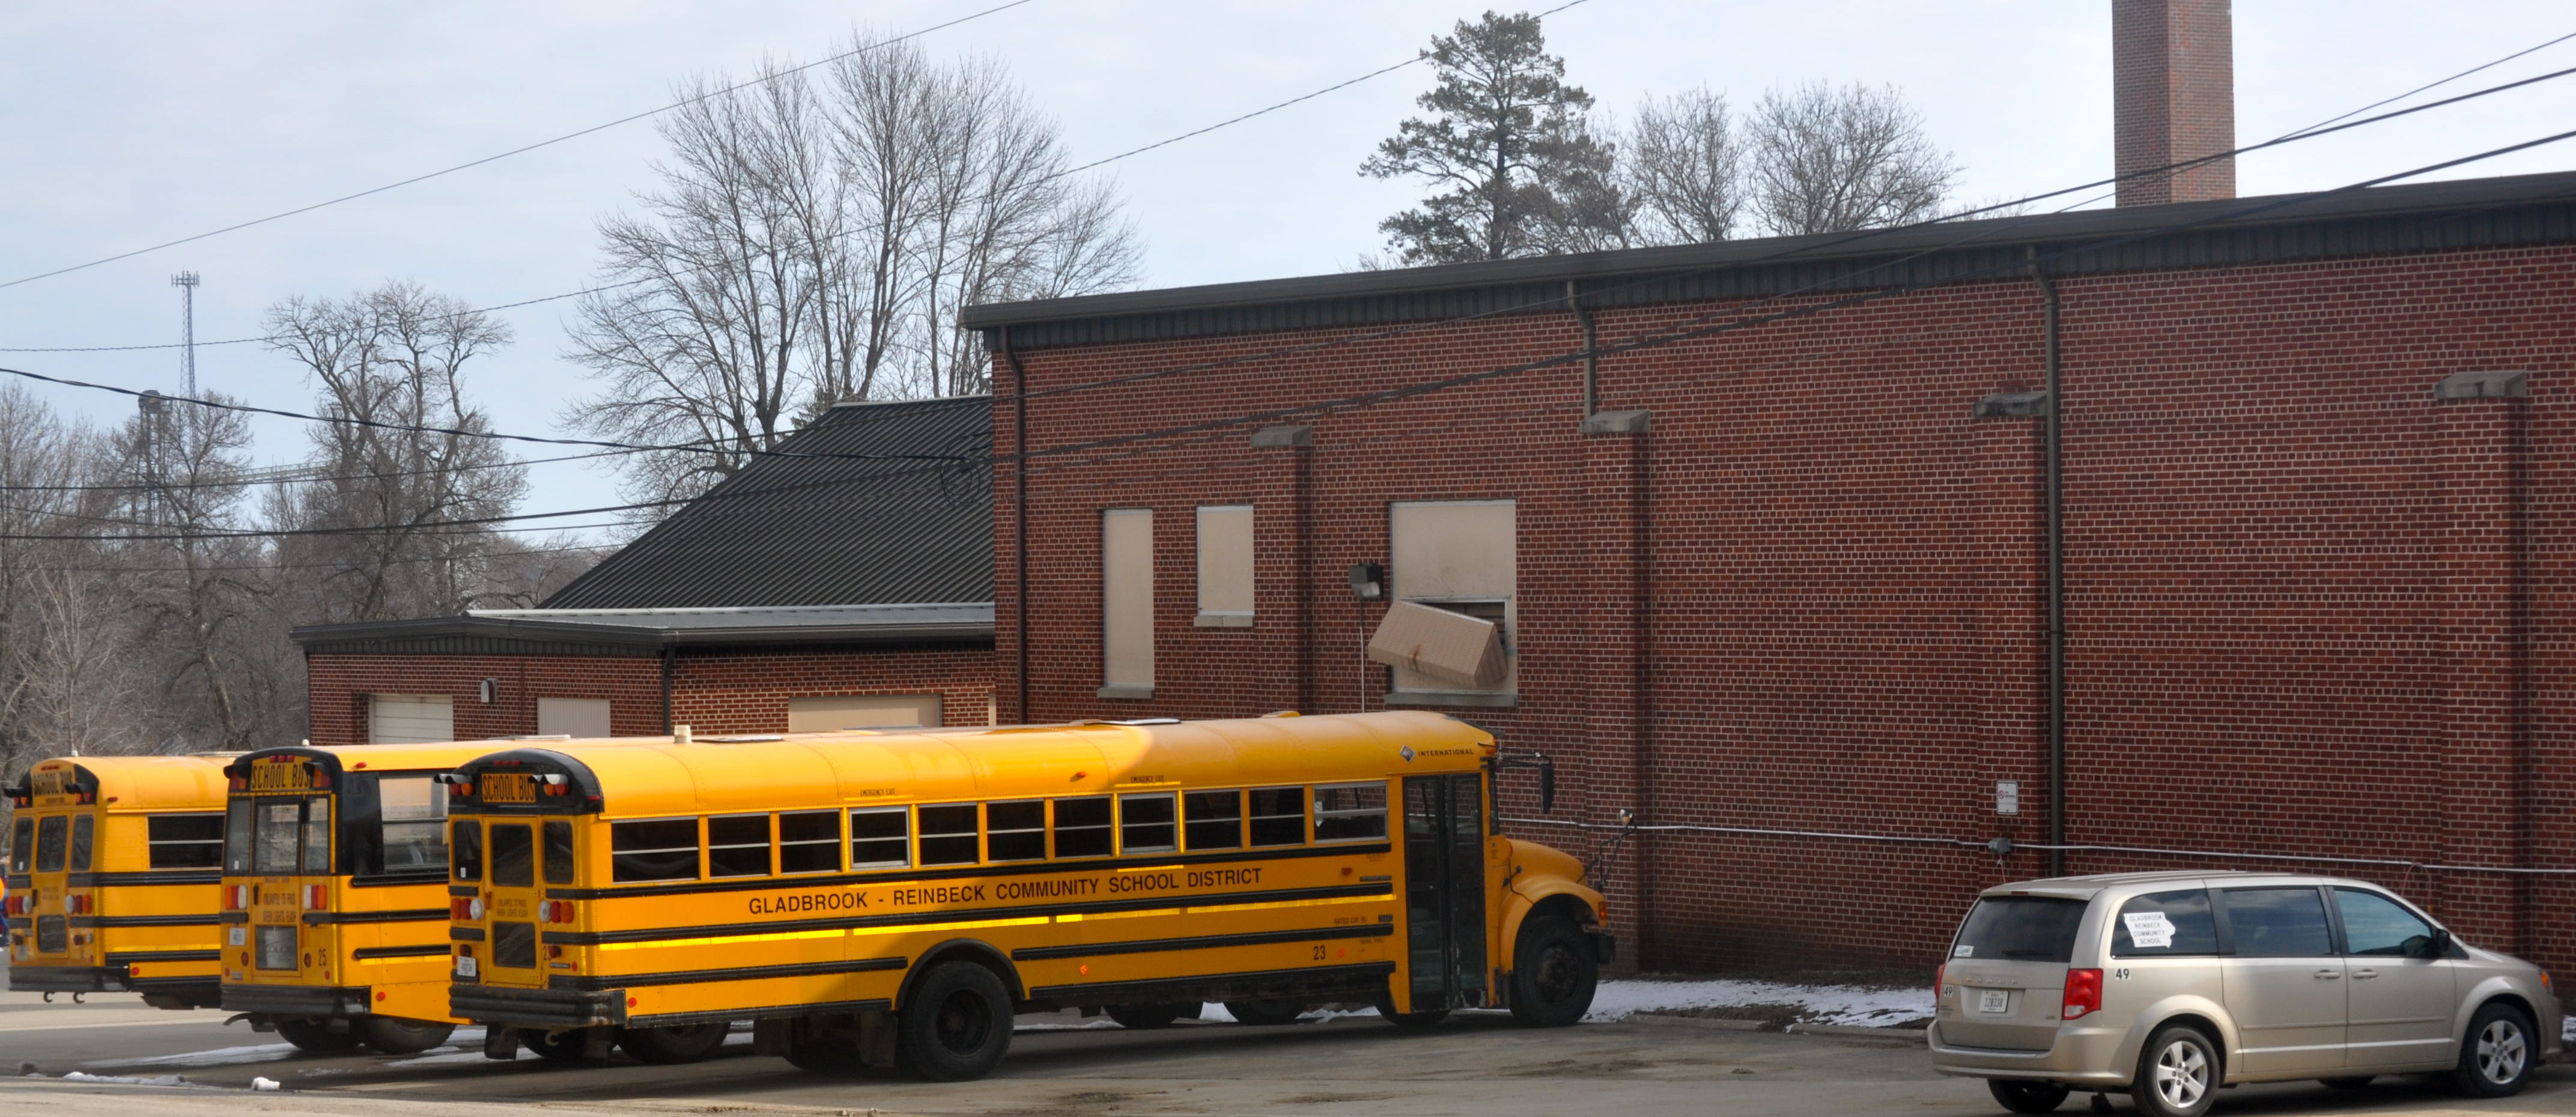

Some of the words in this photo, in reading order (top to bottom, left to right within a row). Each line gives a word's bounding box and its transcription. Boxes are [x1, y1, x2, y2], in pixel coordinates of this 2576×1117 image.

[1418, 748, 1474, 757] INTERNATIONAL
[252, 764, 286, 789] SCHOOL
[292, 764, 309, 787] BUS
[483, 775, 515, 801] SCHOOL
[519, 775, 534, 801] BUS
[749, 892, 868, 915] GLADBROOK
[894, 885, 985, 906] REINBECK
[996, 879, 1099, 900] COMMUNITY
[1109, 874, 1179, 893] SCHOOL
[1188, 868, 1262, 888] DISTRICT
[318, 948, 327, 966] 25
[1313, 945, 1326, 960] 23
[2115, 968, 2130, 979] 49
[1944, 985, 1952, 997] 49
